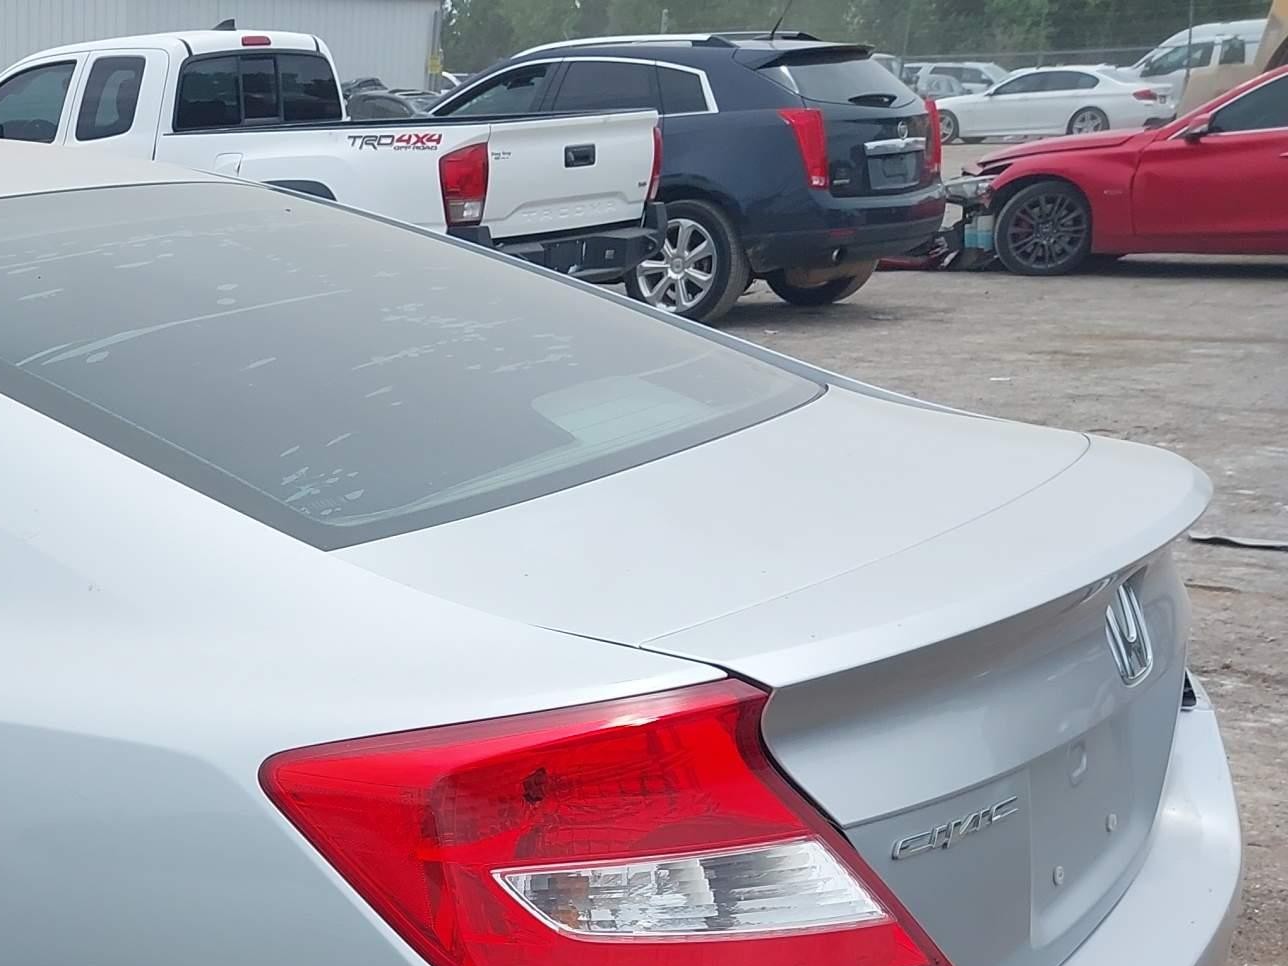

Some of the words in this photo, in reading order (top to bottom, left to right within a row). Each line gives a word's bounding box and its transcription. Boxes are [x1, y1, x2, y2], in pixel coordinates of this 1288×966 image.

[347, 134, 394, 150] TRD
[394, 133, 443, 146] 4X4
[891, 796, 1019, 860] CIVIC
